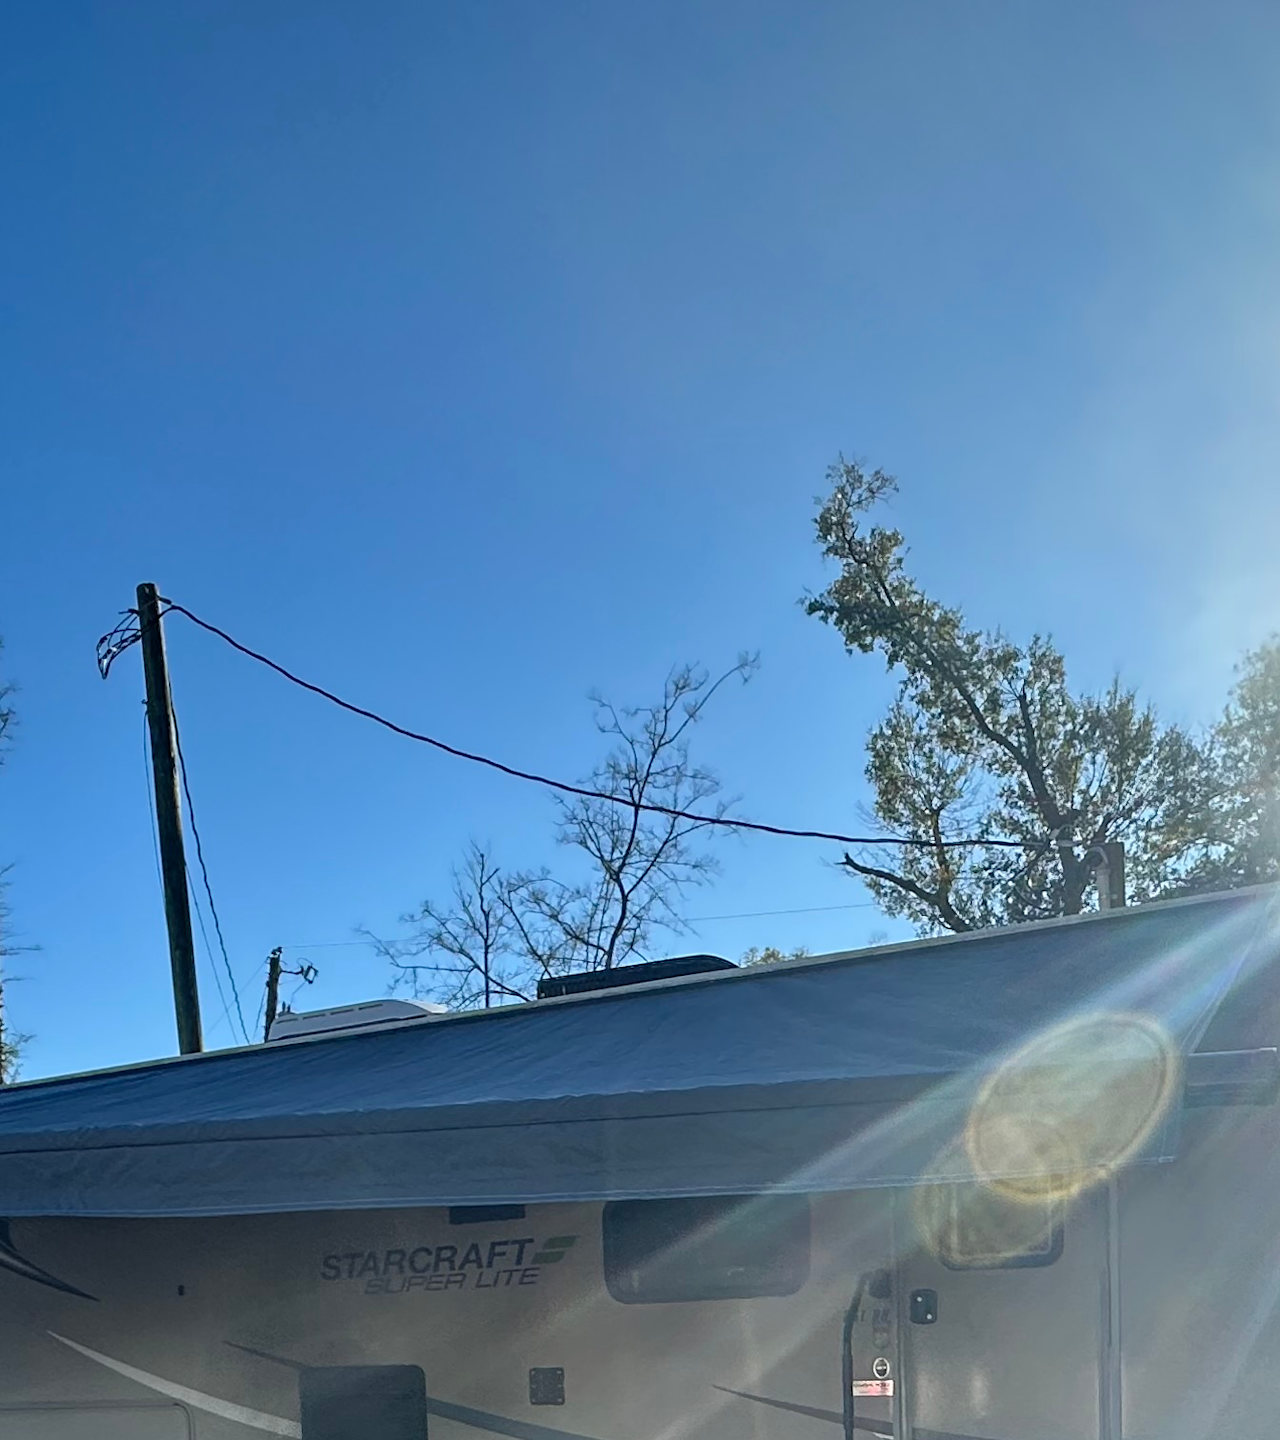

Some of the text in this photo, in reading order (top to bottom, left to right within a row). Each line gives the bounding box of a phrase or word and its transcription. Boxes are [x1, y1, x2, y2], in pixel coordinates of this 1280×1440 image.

[321, 1238, 535, 1281] STARCRAFT
[364, 1267, 541, 1295] SUPER LITE
